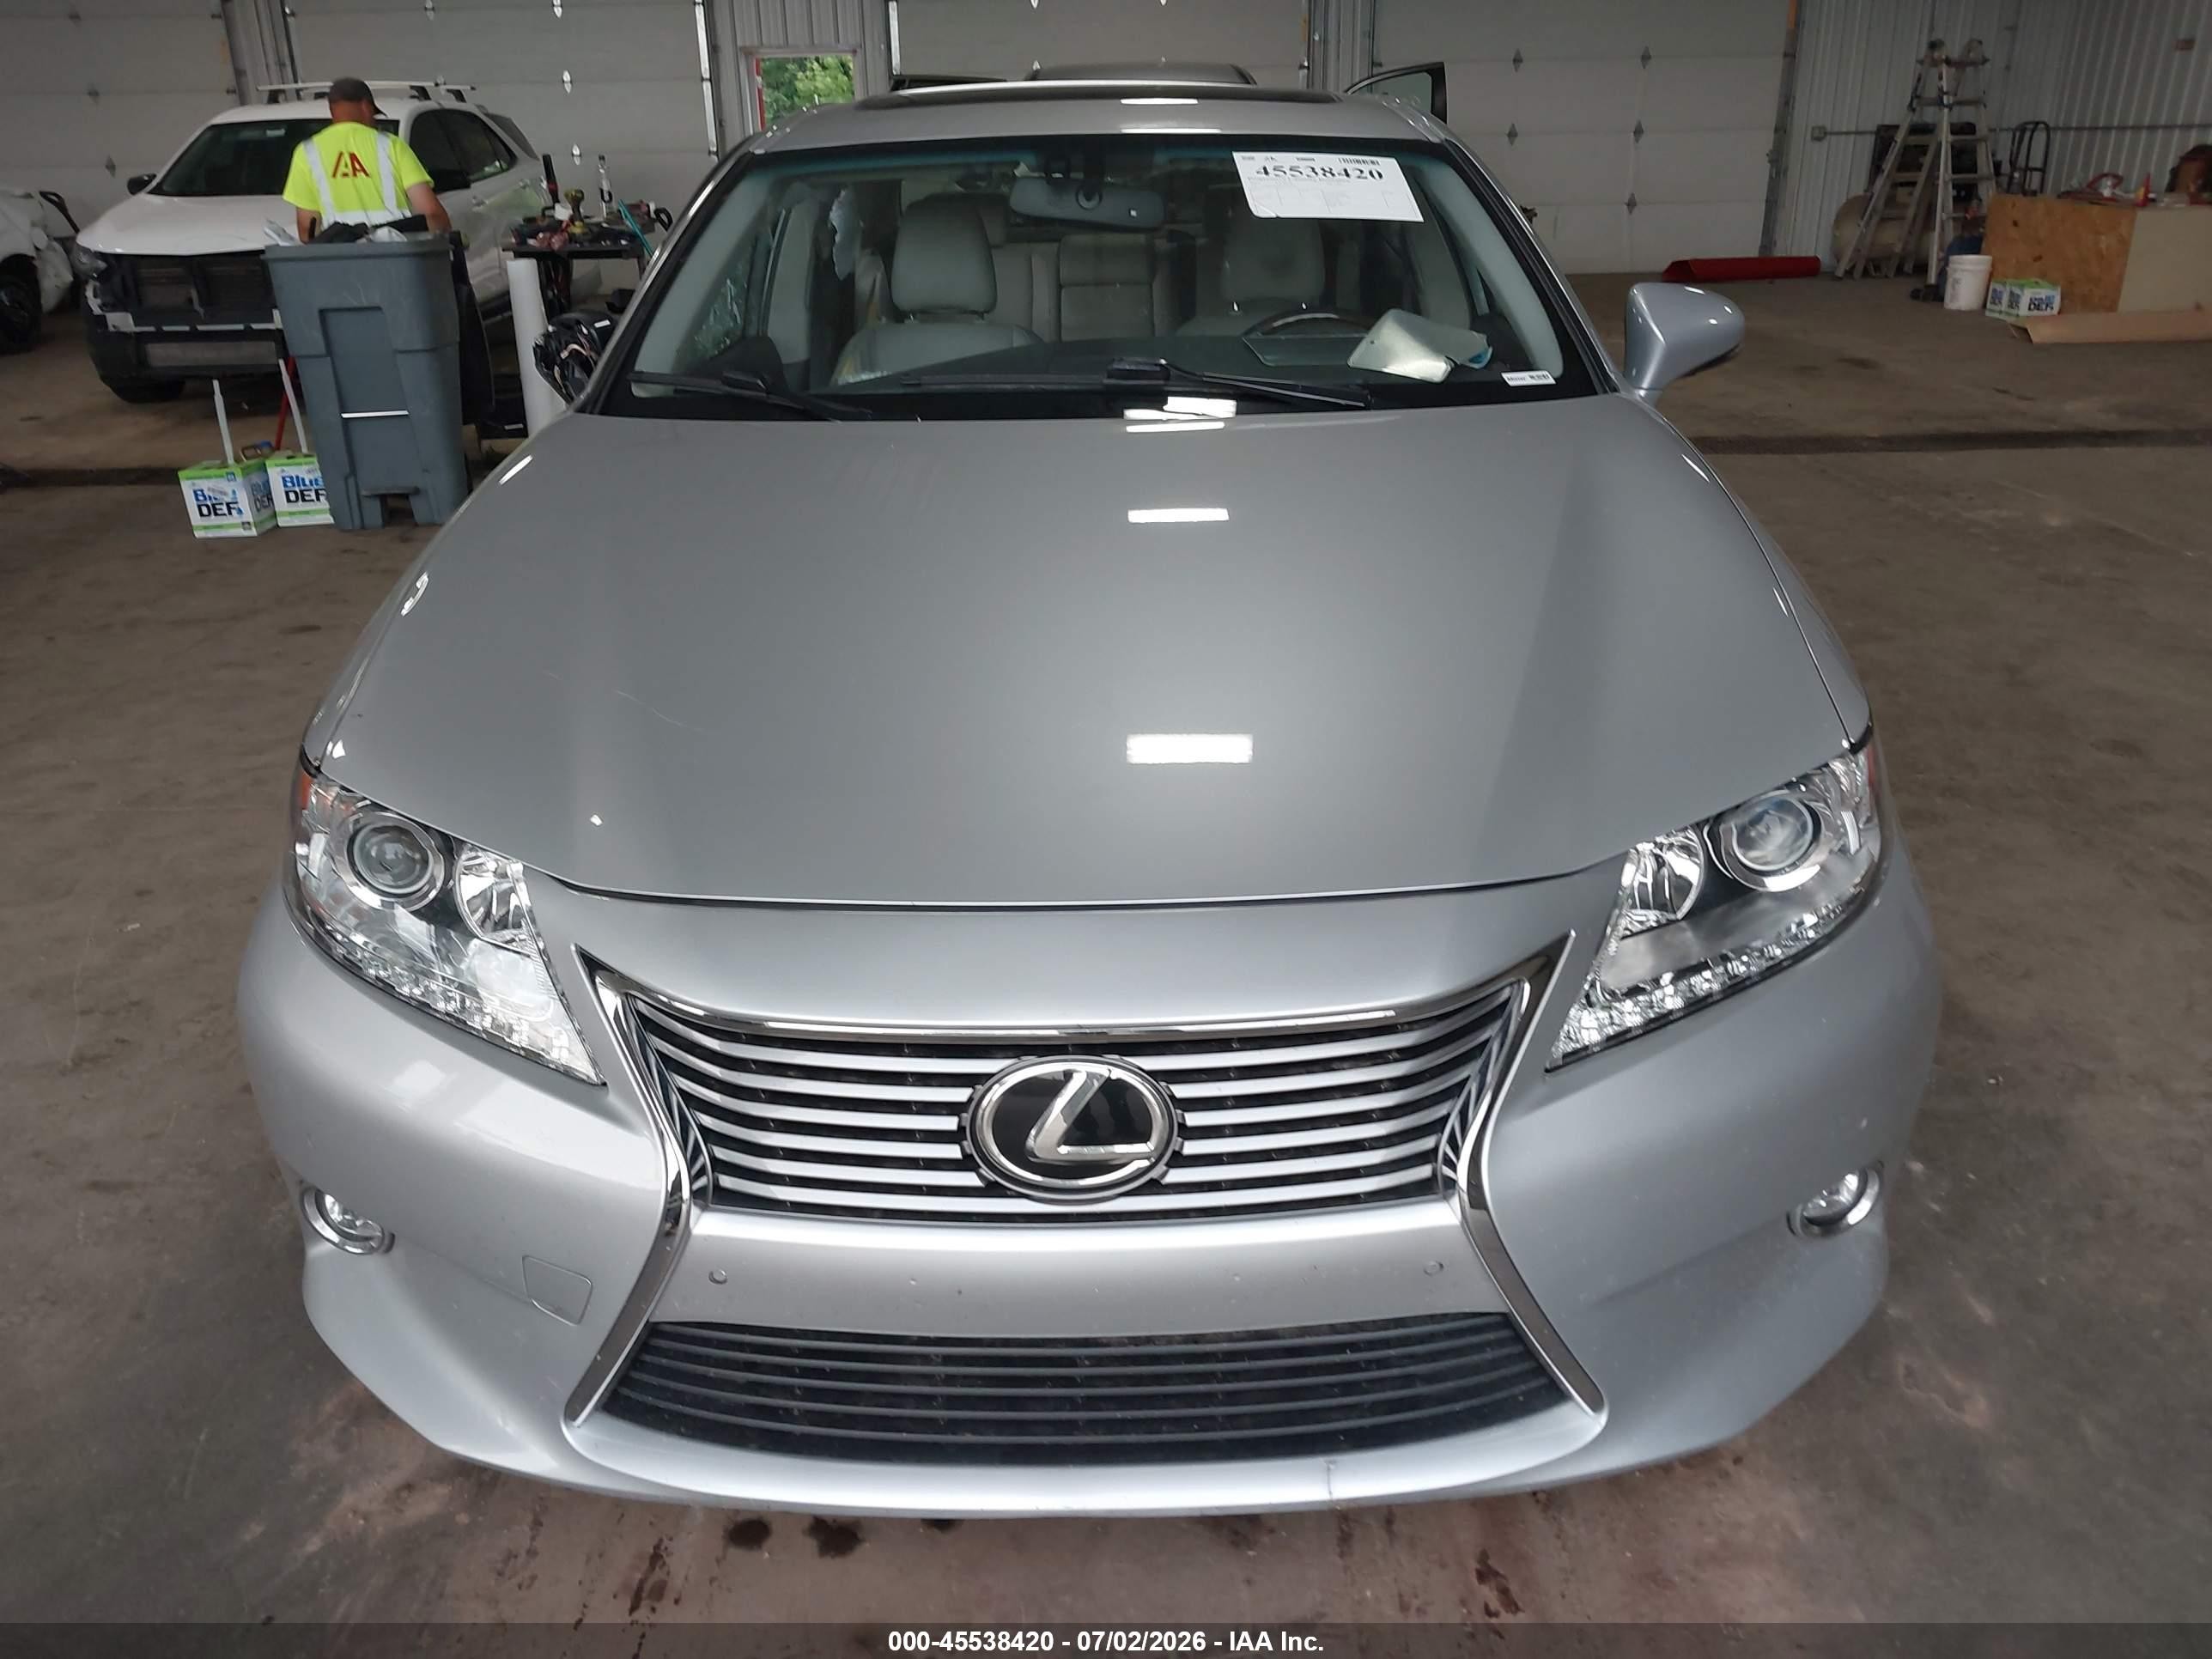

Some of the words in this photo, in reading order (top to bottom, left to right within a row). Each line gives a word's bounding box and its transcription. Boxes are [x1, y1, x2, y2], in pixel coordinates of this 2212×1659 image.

[1255, 164, 1384, 181] 45538420
[284, 488, 327, 504] DEF
[197, 501, 240, 517] DEF
